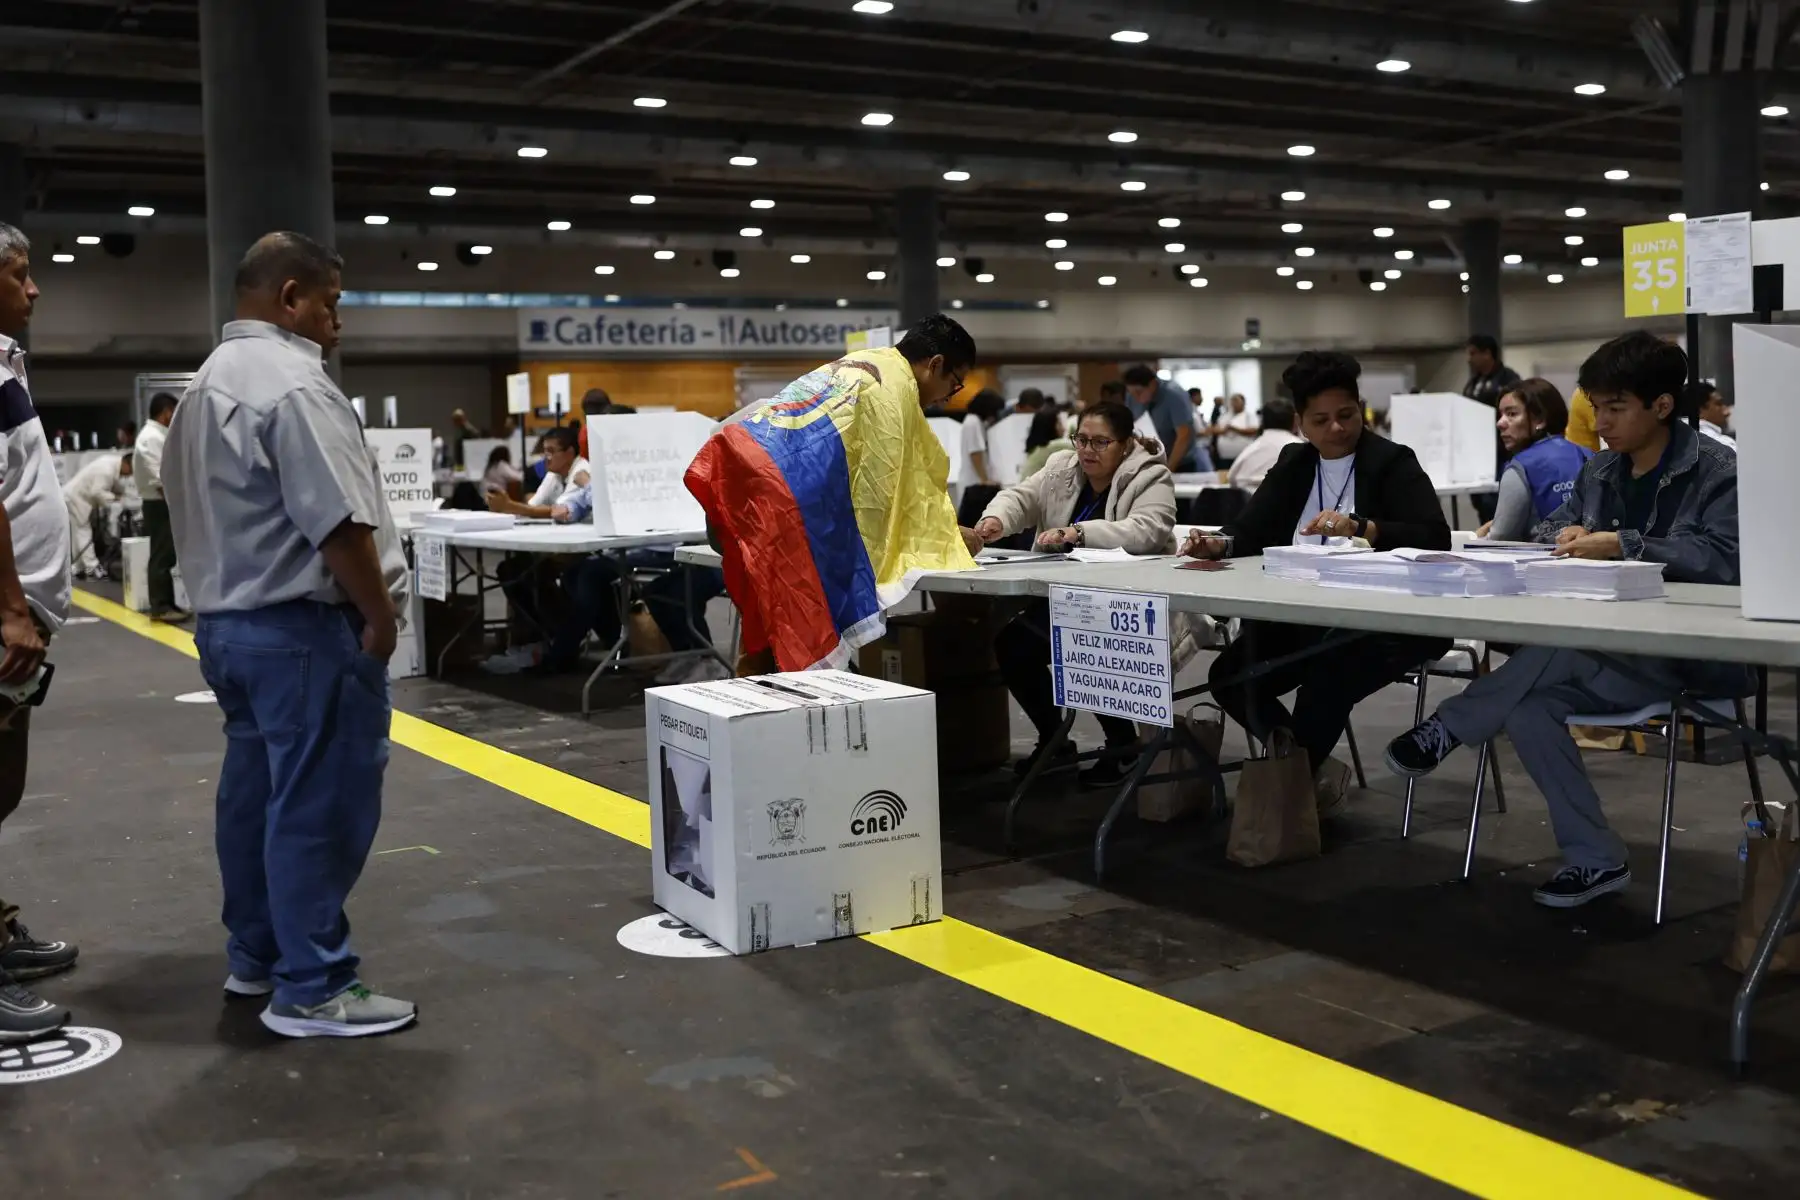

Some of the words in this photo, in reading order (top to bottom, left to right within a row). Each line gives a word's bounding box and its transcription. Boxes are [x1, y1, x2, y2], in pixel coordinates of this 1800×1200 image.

[1630, 238, 1679, 256] JUNTA
[1632, 257, 1678, 292] 35
[553, 314, 697, 346] Cafetería
[383, 471, 418, 485] VOTO
[1108, 600, 1132, 611] JUNTA
[1110, 611, 1140, 634] 035
[1072, 633, 1101, 649] VELIZ
[1103, 637, 1155, 656] MOREIRA
[1064, 650, 1096, 667] JAIRO
[1097, 655, 1166, 678] ALEXANDER
[1068, 671, 1120, 693] YAGUANA
[1121, 680, 1162, 699] ACARO
[1066, 689, 1100, 707] EDWIN
[1102, 696, 1167, 720] FRANCISCO
[660, 713, 679, 732] PEGAR
[679, 720, 708, 742] ETIQUETA
[850, 815, 888, 836] CNE
[838, 840, 864, 849] CONSEJO
[863, 837, 890, 846] NACIONAL
[891, 832, 921, 842] ELECTORAL
[756, 850, 788, 861] REPÚBLICA
[788, 849, 799, 857] DEL
[800, 846, 827, 856] ECUADOR
